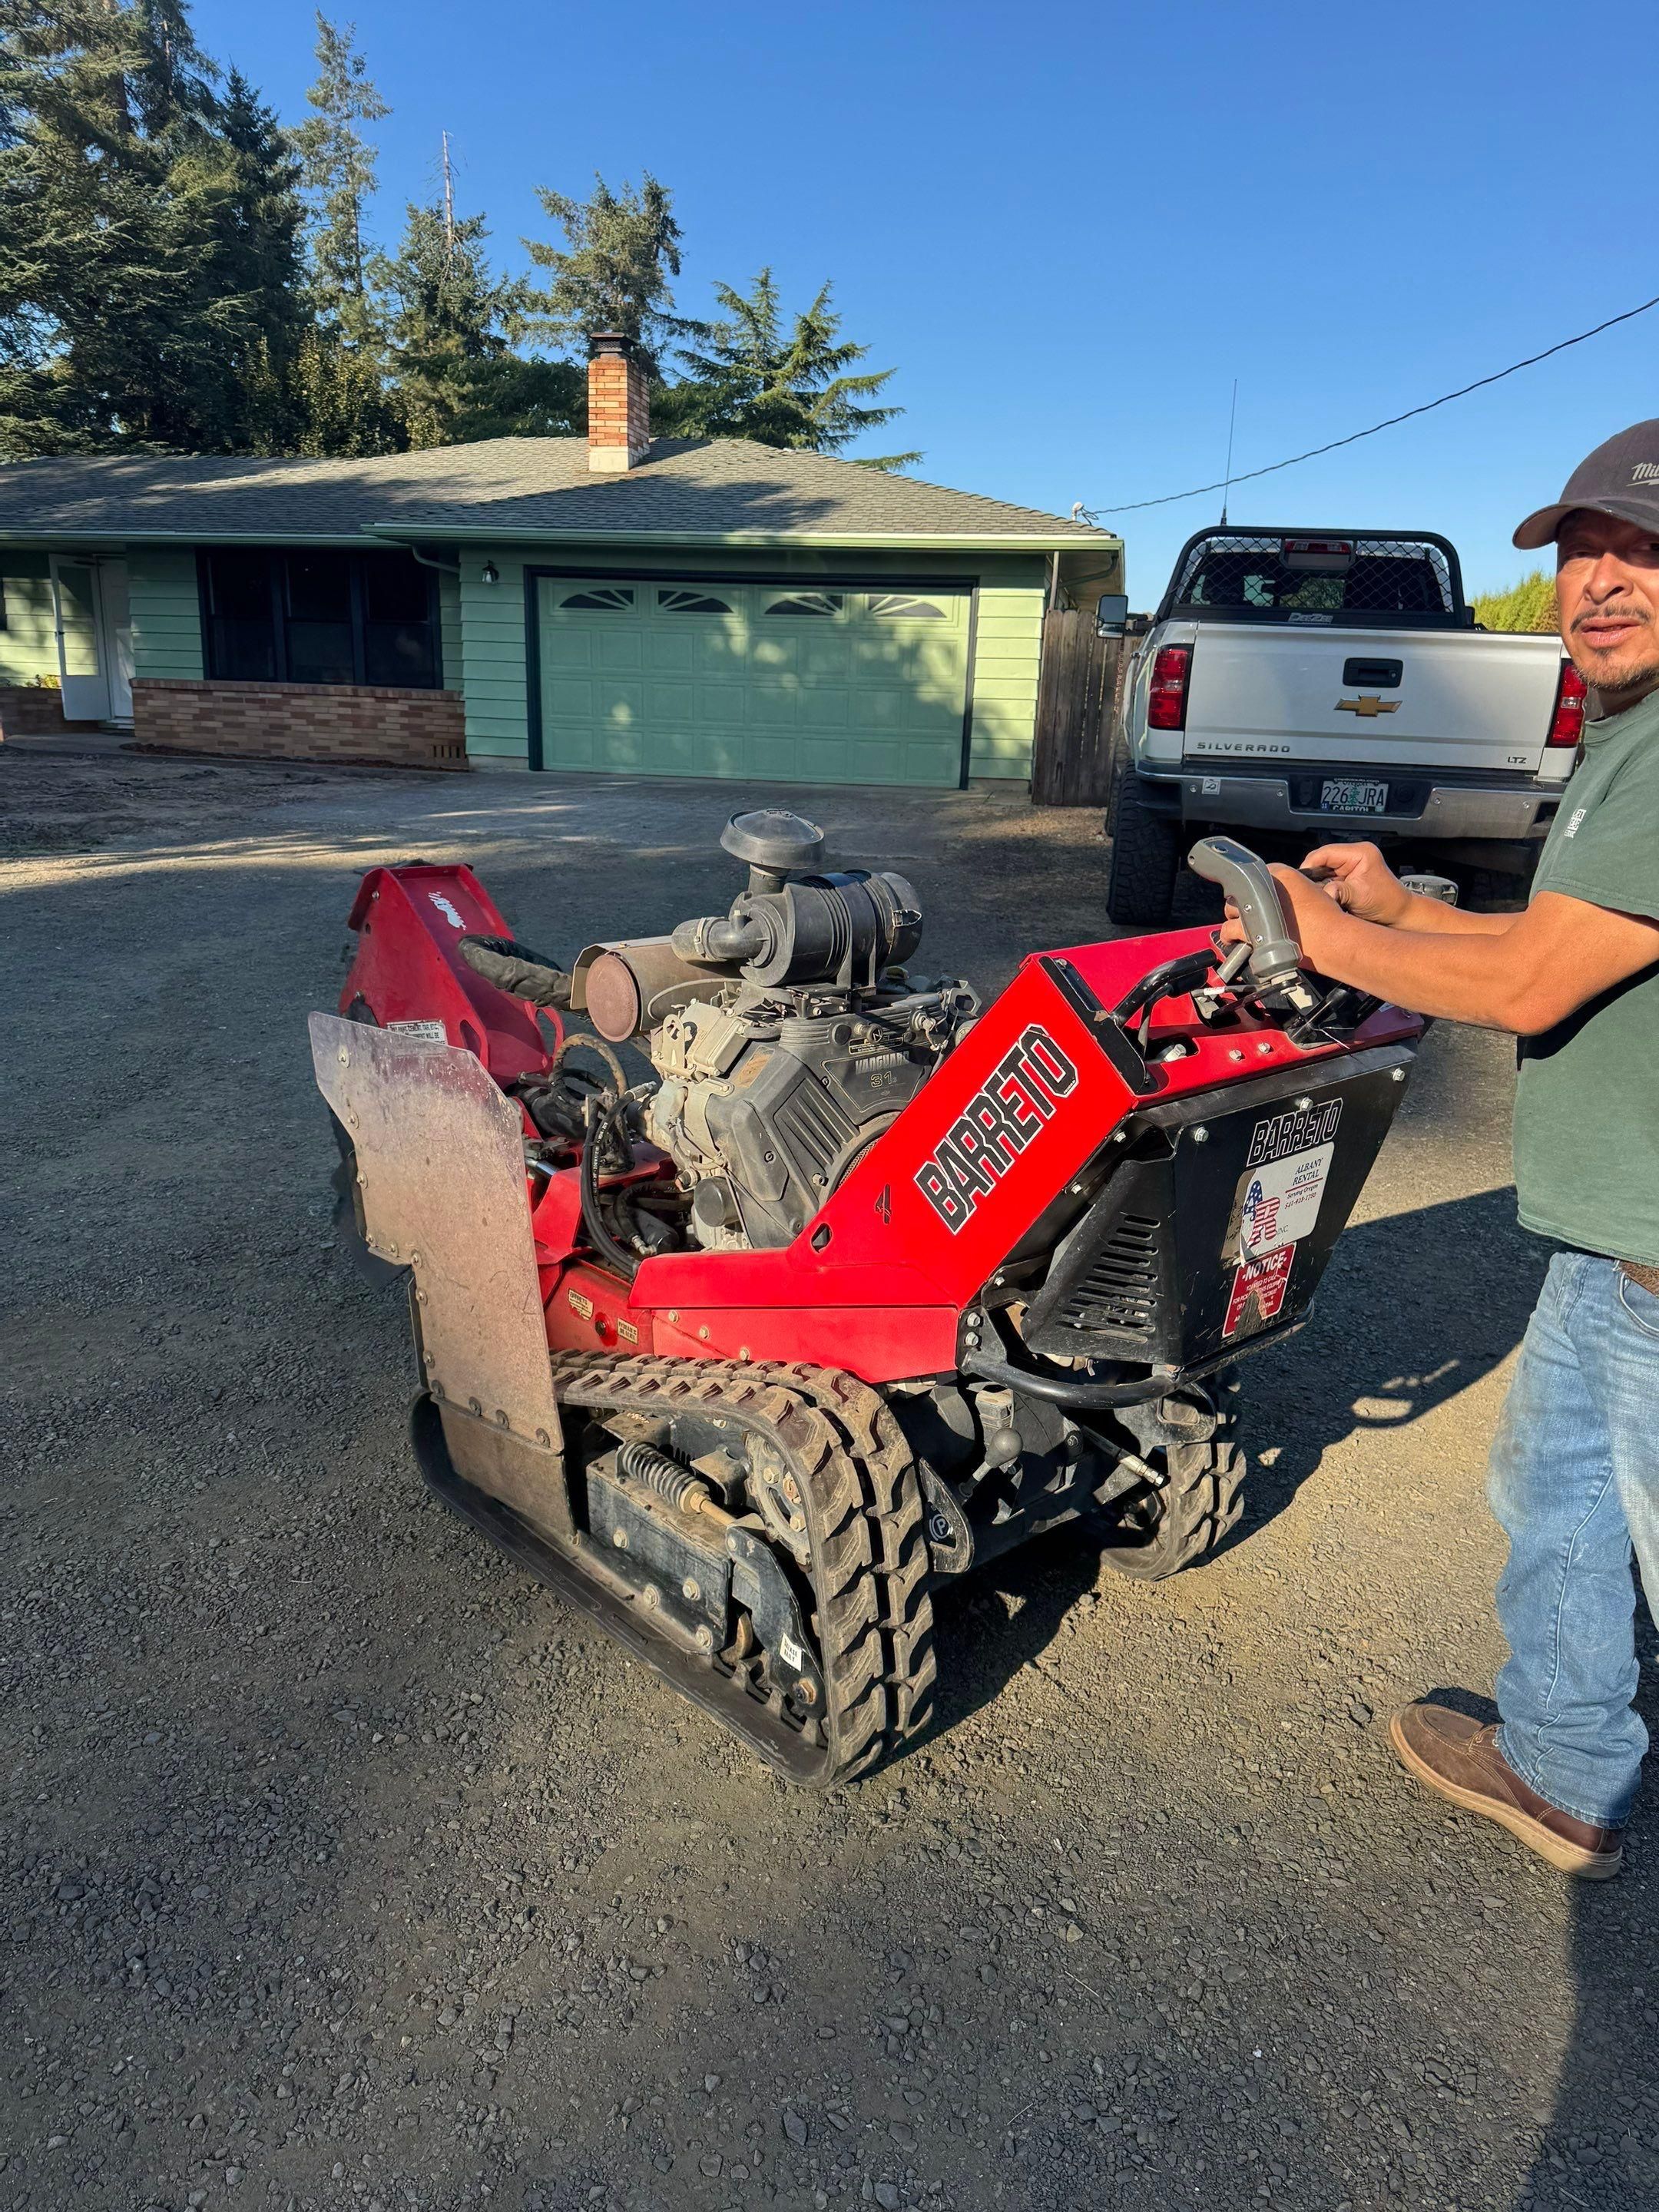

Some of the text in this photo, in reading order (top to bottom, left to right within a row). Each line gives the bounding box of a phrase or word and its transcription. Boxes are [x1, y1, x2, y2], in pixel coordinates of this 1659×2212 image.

[1197, 742, 1290, 753] SILVERADO
[1322, 786, 1384, 806] 226 JRA
[855, 1051, 910, 1075] VANGUARD
[870, 1071, 892, 1088] 31
[913, 1023, 1079, 1235] BARRETO
[1246, 1098, 1343, 1167] BARRETO
[1295, 1157, 1323, 1174] ALBANY
[1293, 1169, 1320, 1186] RENTAL
